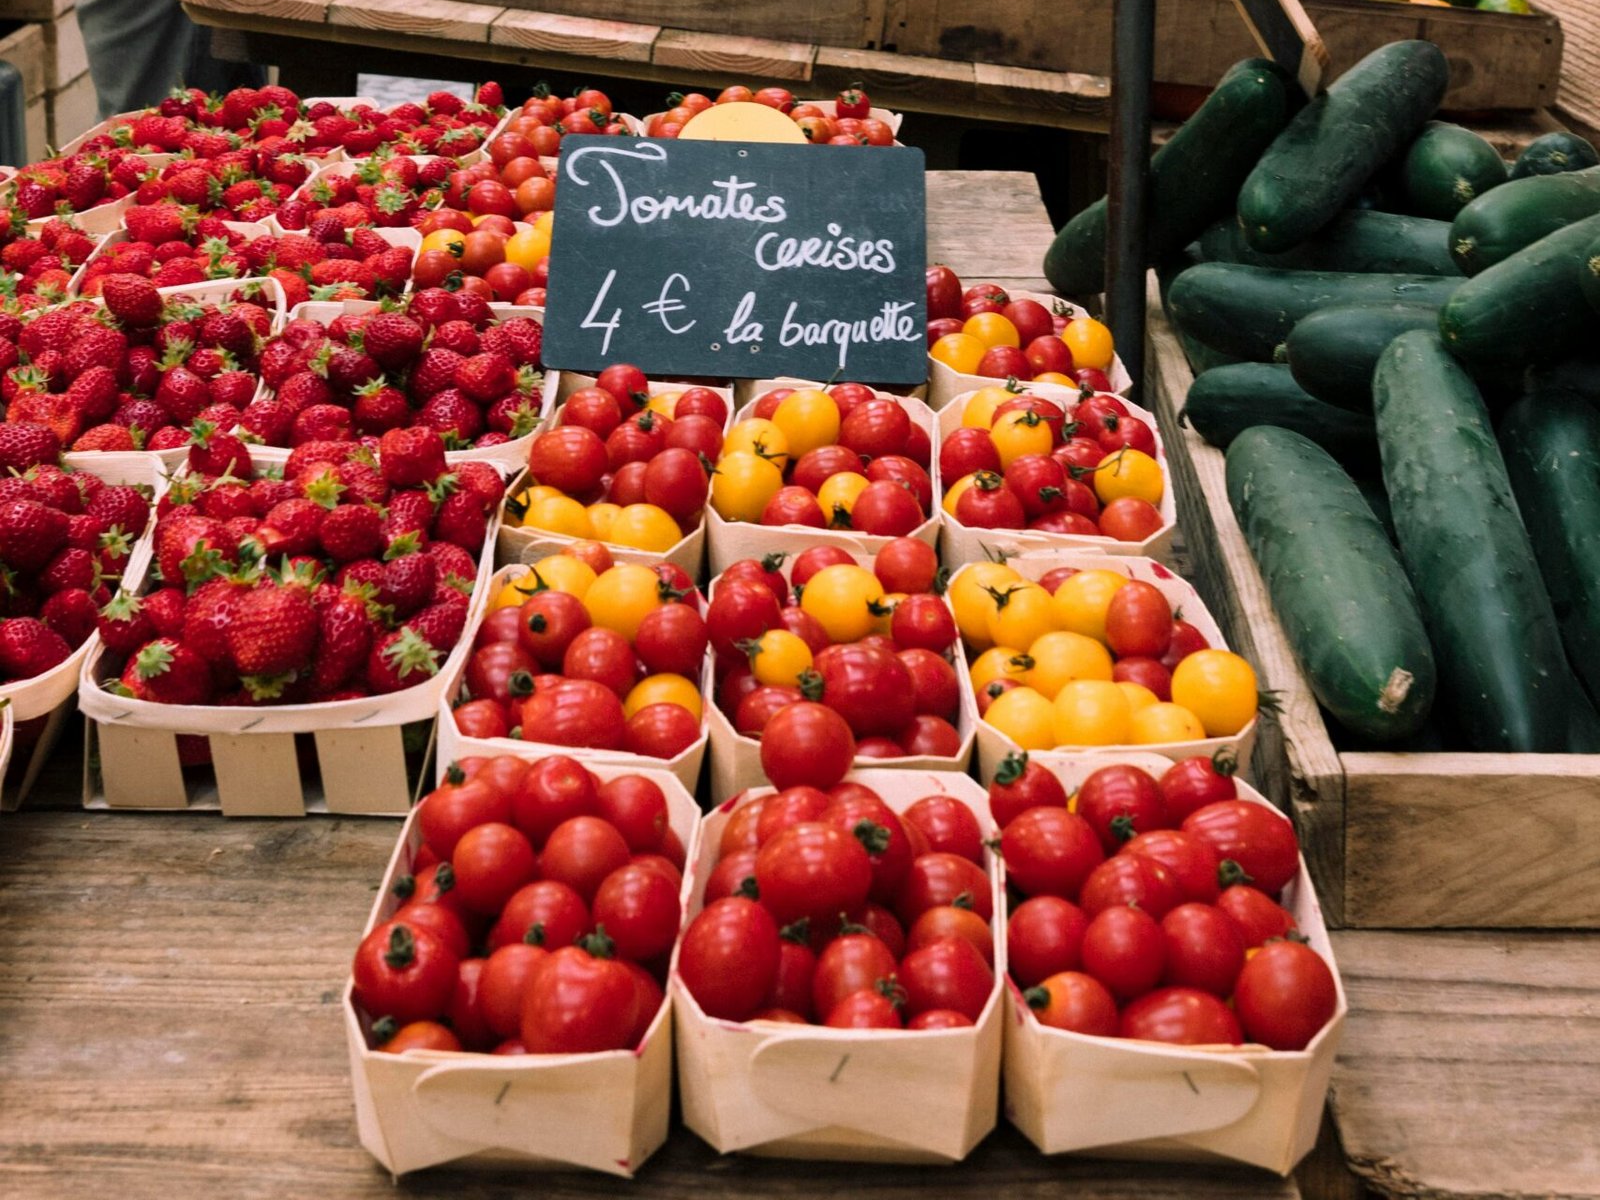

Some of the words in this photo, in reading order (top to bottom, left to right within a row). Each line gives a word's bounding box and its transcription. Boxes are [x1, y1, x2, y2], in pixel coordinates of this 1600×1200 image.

[565, 141, 788, 227] Tomates
[580, 269, 622, 356] 4
[641, 272, 697, 335] €
[723, 291, 764, 345] la
[778, 301, 923, 370] barquette
